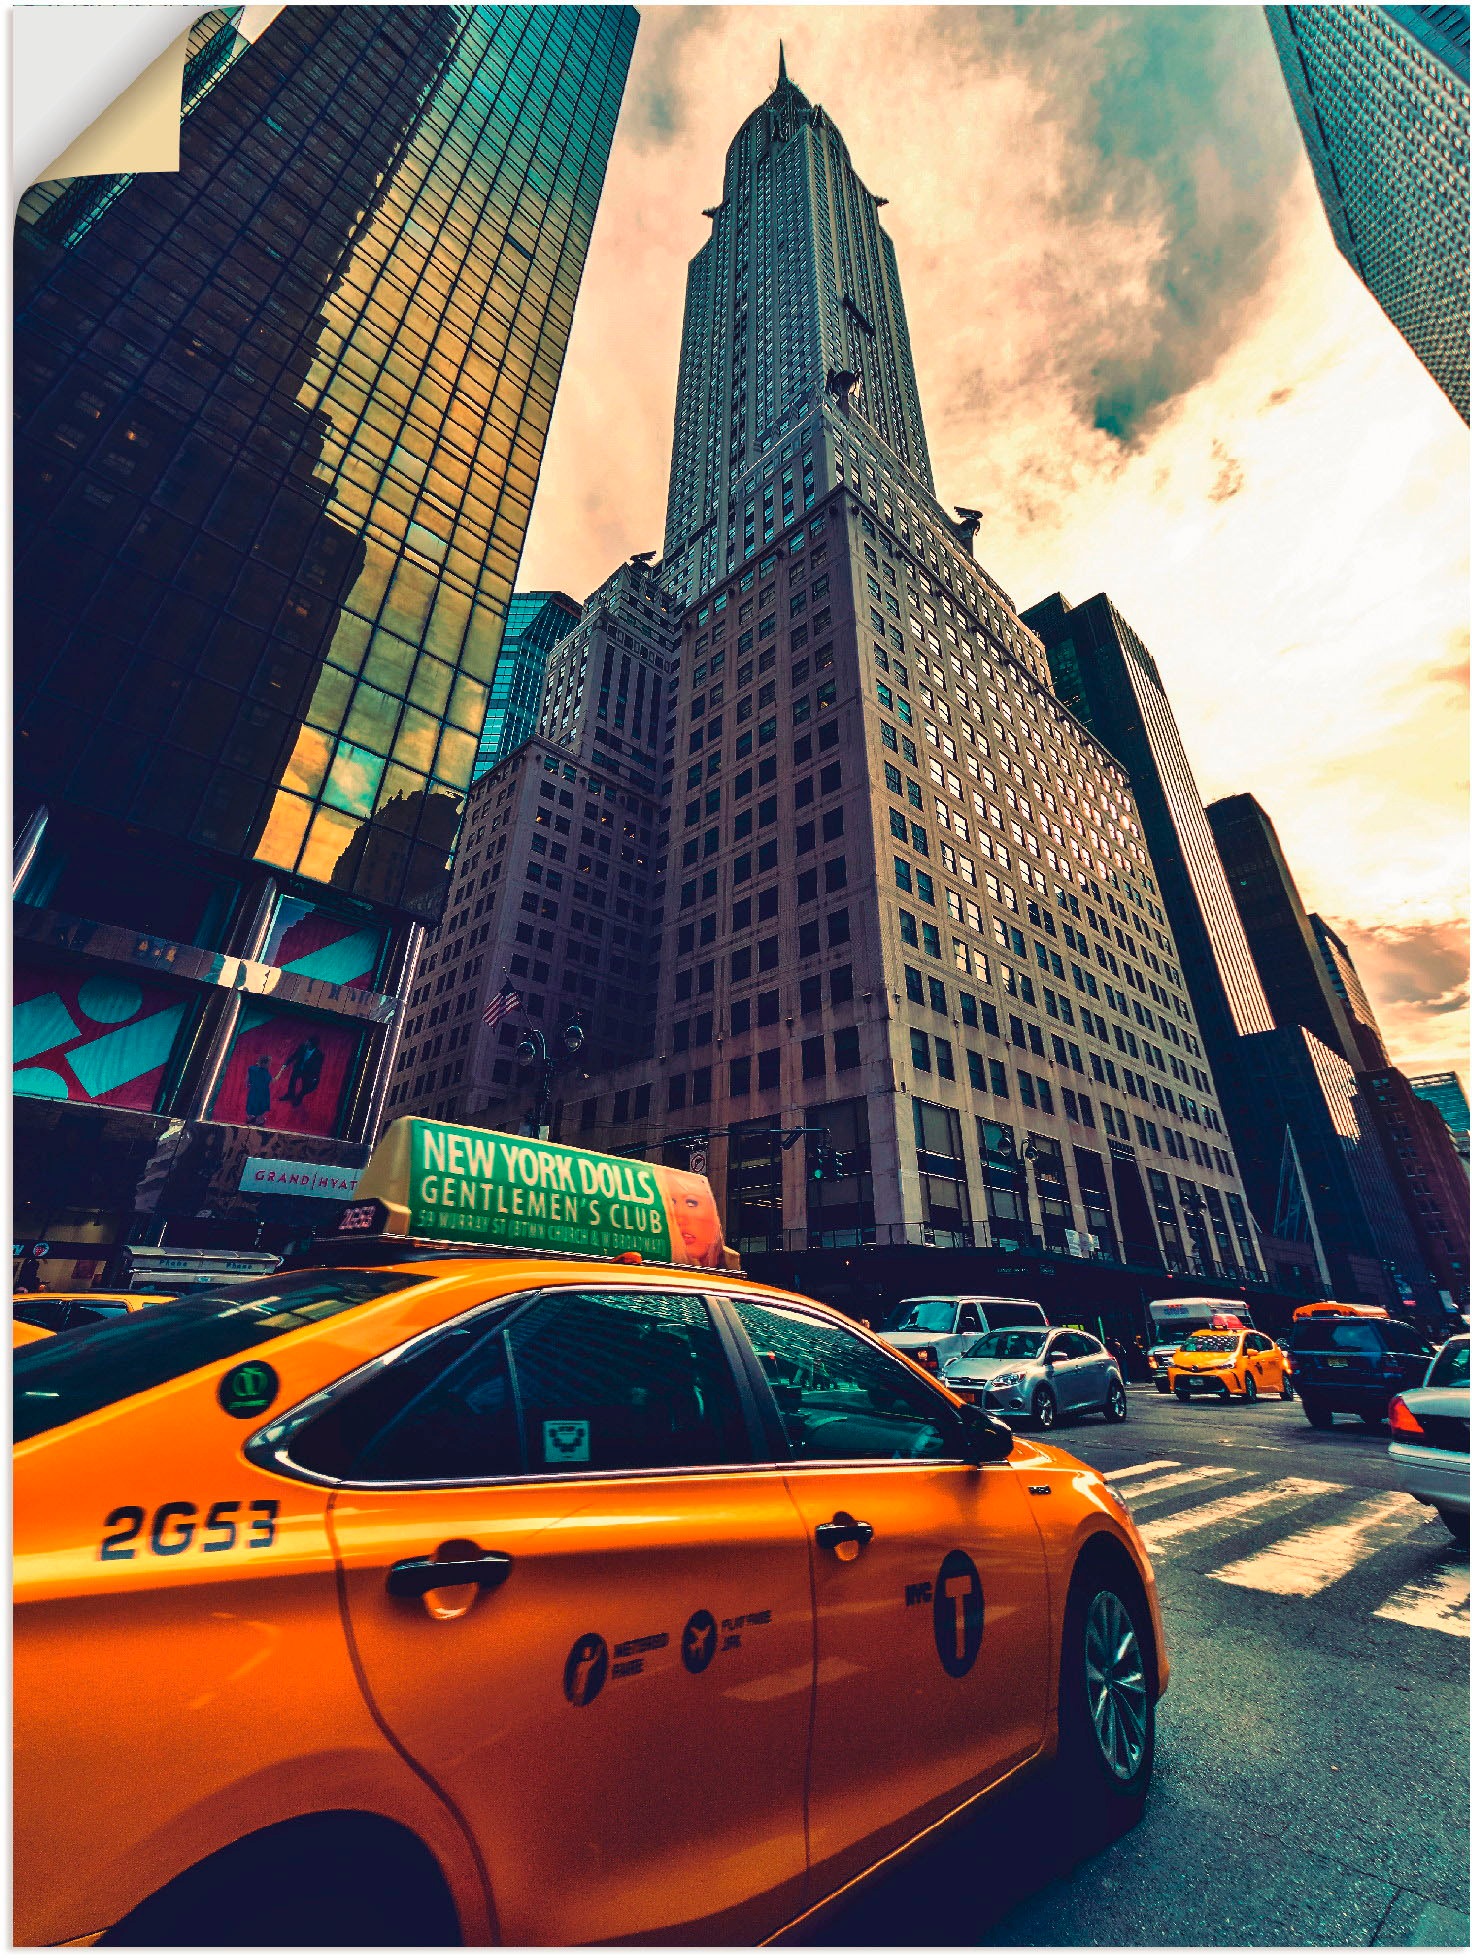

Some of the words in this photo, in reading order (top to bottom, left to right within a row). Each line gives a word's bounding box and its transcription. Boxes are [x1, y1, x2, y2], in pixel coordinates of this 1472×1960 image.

[255, 1170, 310, 1186] GRAND
[423, 1129, 495, 1179] NEW
[500, 1143, 576, 1194] YORK
[577, 1158, 655, 1205] DOLLS
[421, 1175, 600, 1226] GENTLEMEN'S
[609, 1203, 663, 1234] CLUB
[100, 1500, 279, 1561] 2G53
